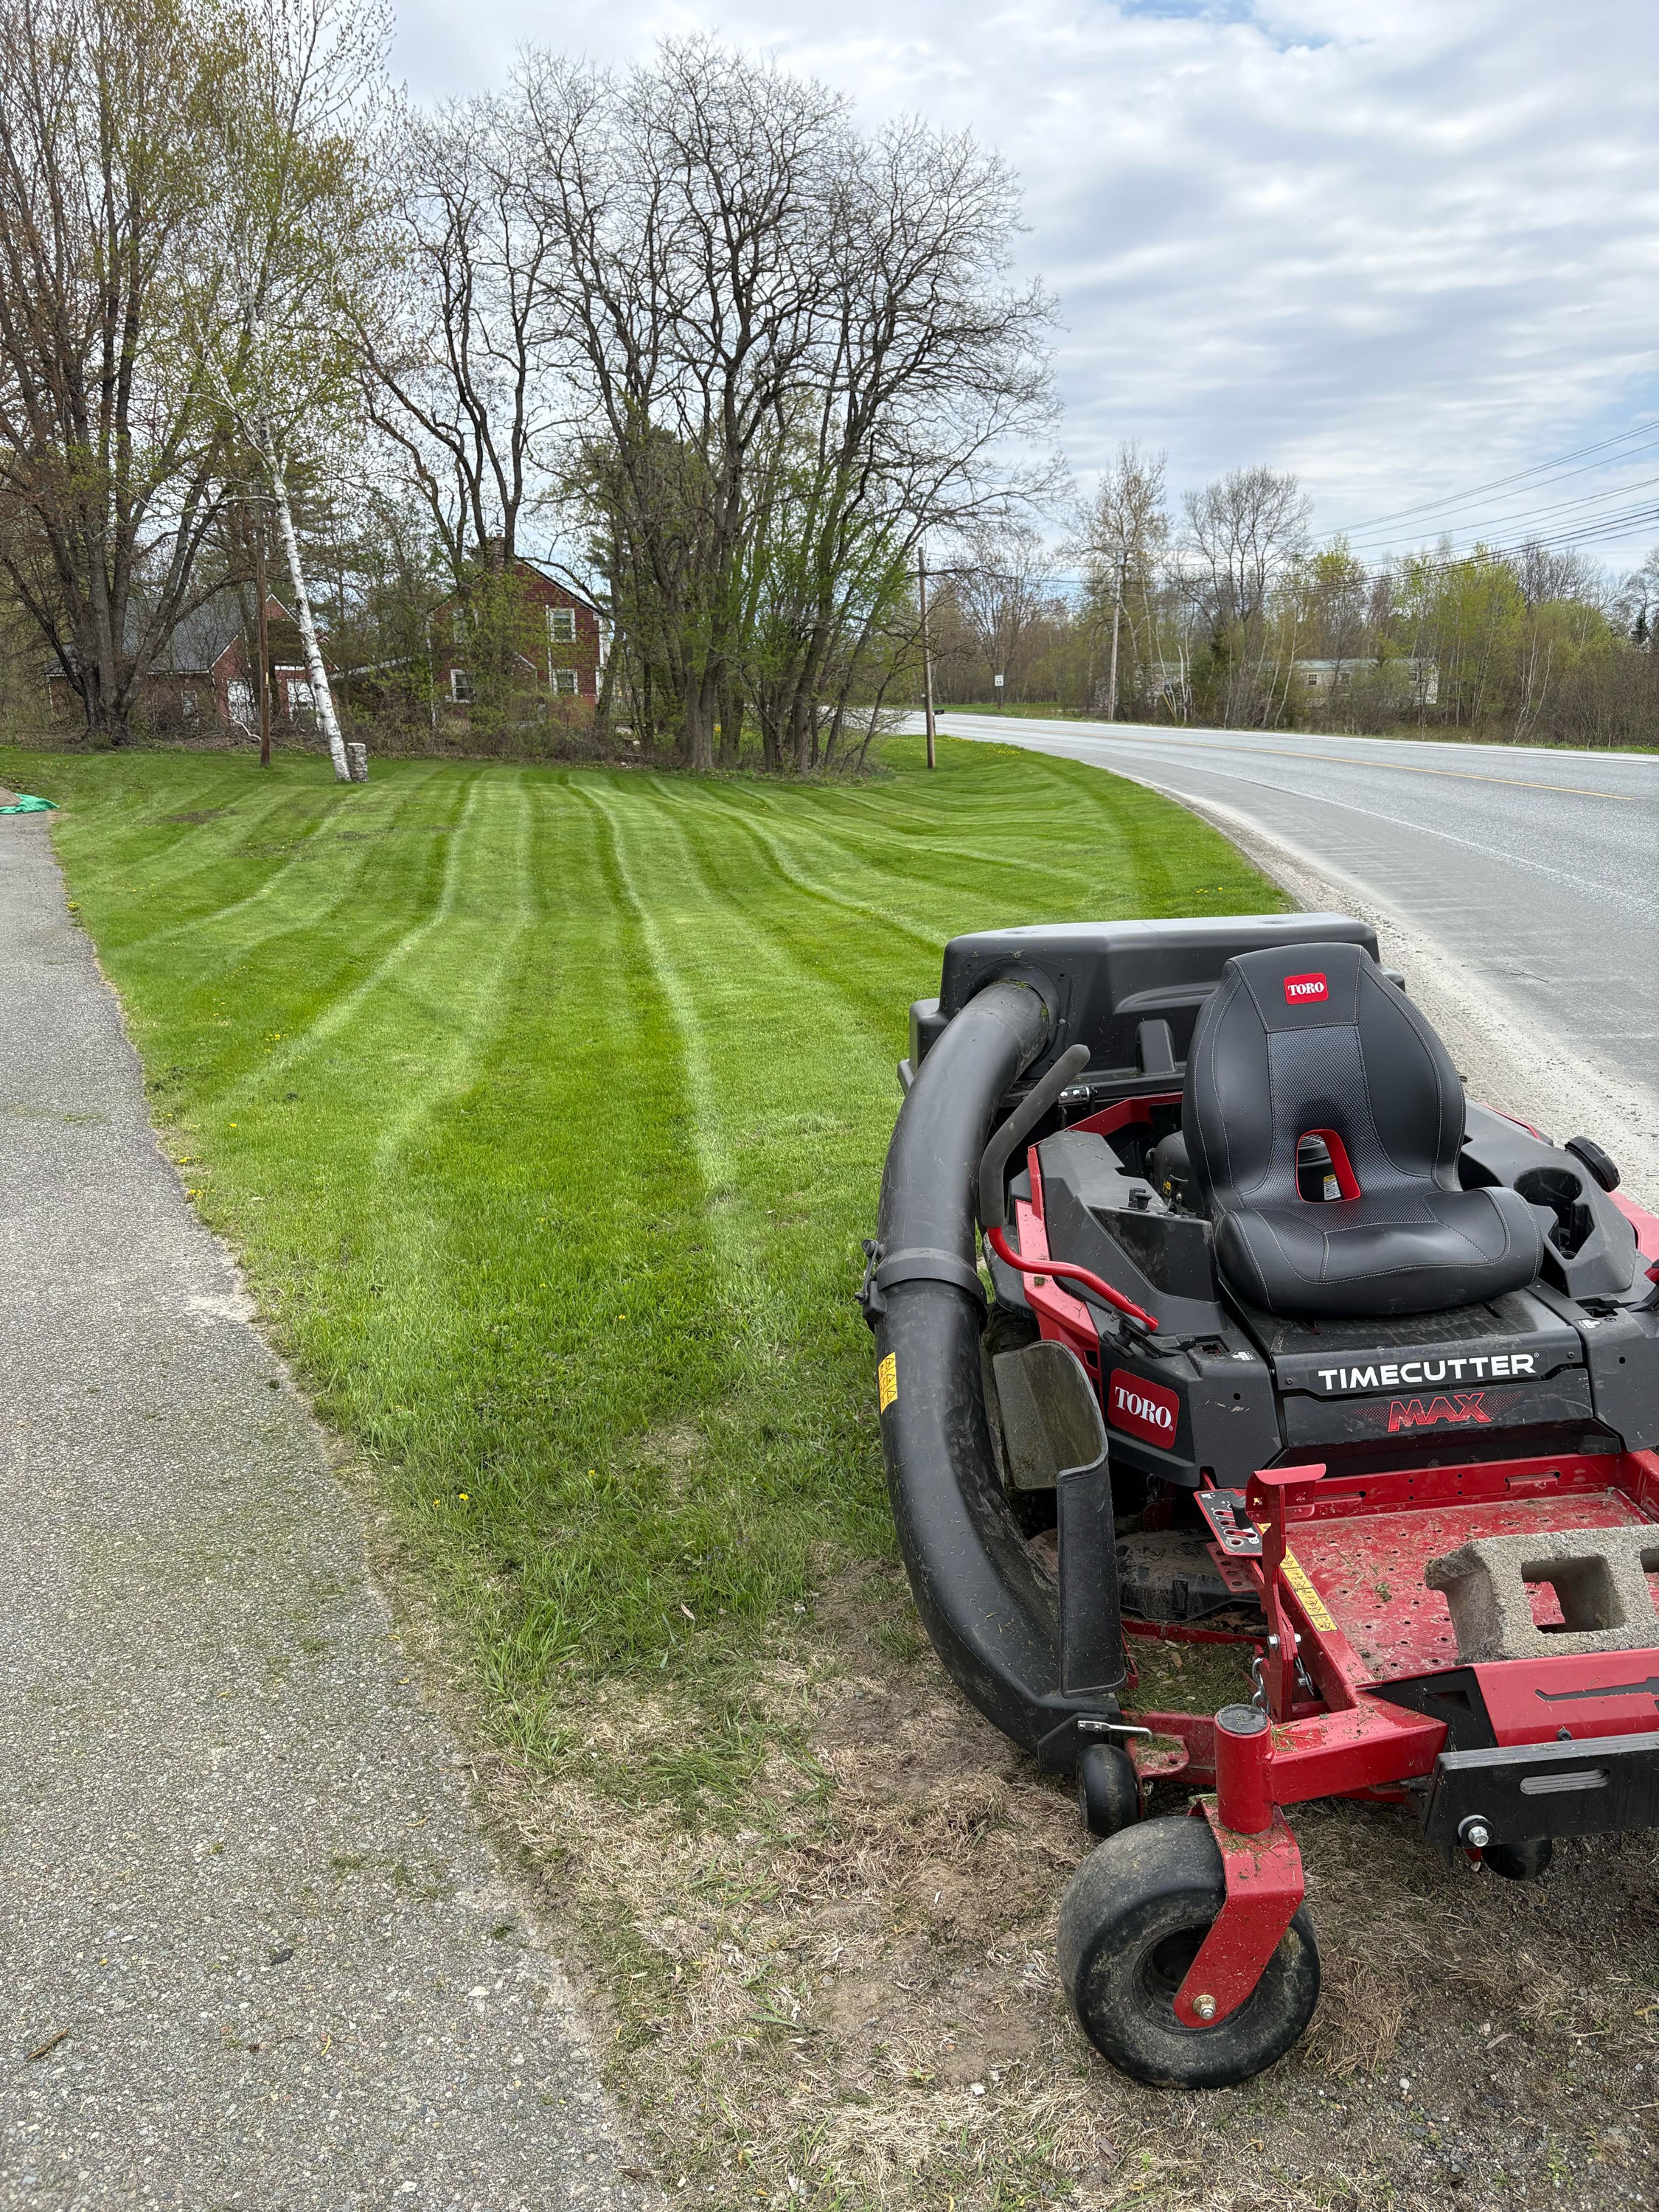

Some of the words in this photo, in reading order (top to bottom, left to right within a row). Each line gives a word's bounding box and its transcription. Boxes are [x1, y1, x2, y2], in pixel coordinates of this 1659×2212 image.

[1287, 981, 1324, 996] TORO
[1318, 1354, 1537, 1391] TIMECUTTER
[1114, 1386, 1172, 1428] TORO
[1388, 1392, 1492, 1433] MAX
